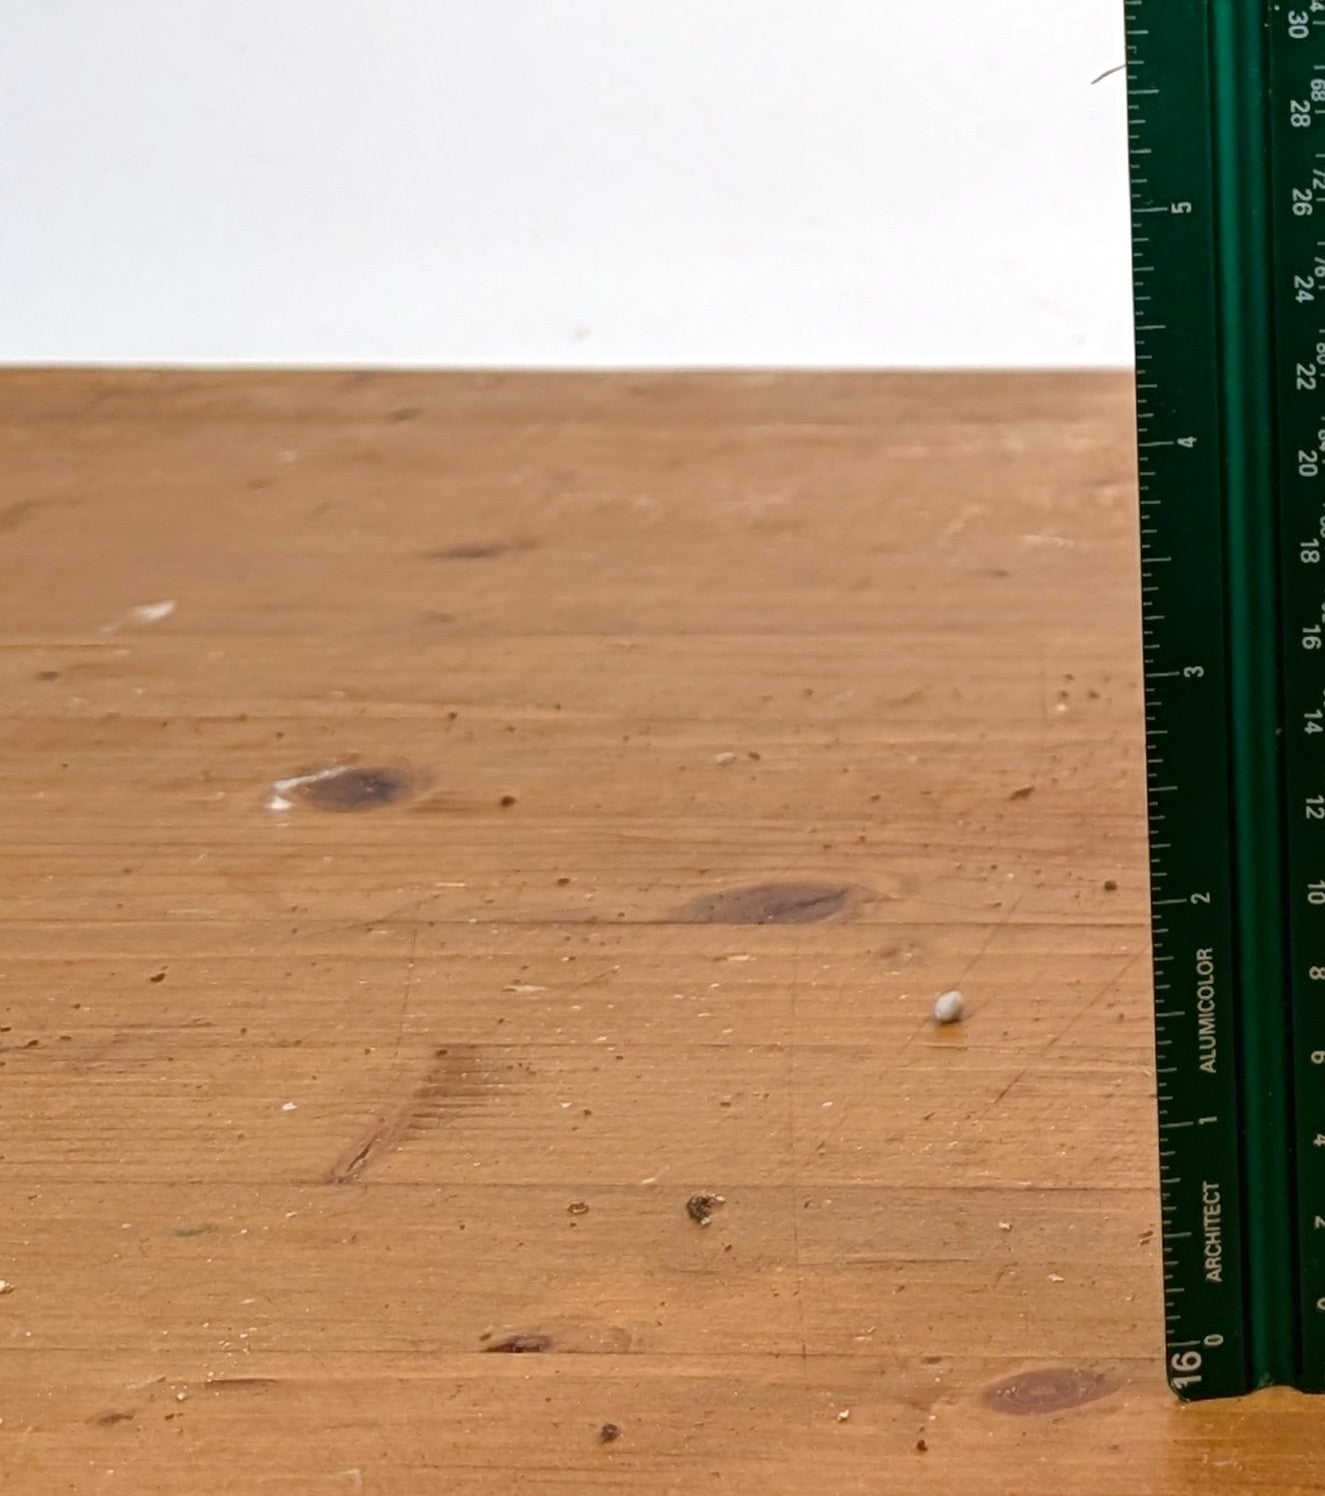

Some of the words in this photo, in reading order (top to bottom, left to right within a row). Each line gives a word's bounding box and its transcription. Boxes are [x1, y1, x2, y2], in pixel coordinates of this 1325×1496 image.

[1288, 11, 1309, 38] 30
[1290, 100, 1310, 128] 28
[1171, 202, 1191, 214] 5
[1292, 188, 1313, 216] 26
[1294, 275, 1314, 303] 24
[1296, 363, 1316, 390] 22
[1177, 437, 1197, 448] 4
[1298, 450, 1318, 477] 20
[1300, 538, 1320, 563] 18
[1302, 624, 1321, 649] 16
[1183, 665, 1204, 678] 3
[1304, 710, 1323, 734] 14
[1306, 795, 1325, 819] 12
[1190, 892, 1210, 904] 2
[1196, 947, 1217, 1074] ALUMICOLOR
[1198, 1116, 1218, 1125] 1
[1203, 1181, 1222, 1283] ARCHITECT
[1203, 1334, 1224, 1347] 0
[1171, 1351, 1202, 1389] 16
